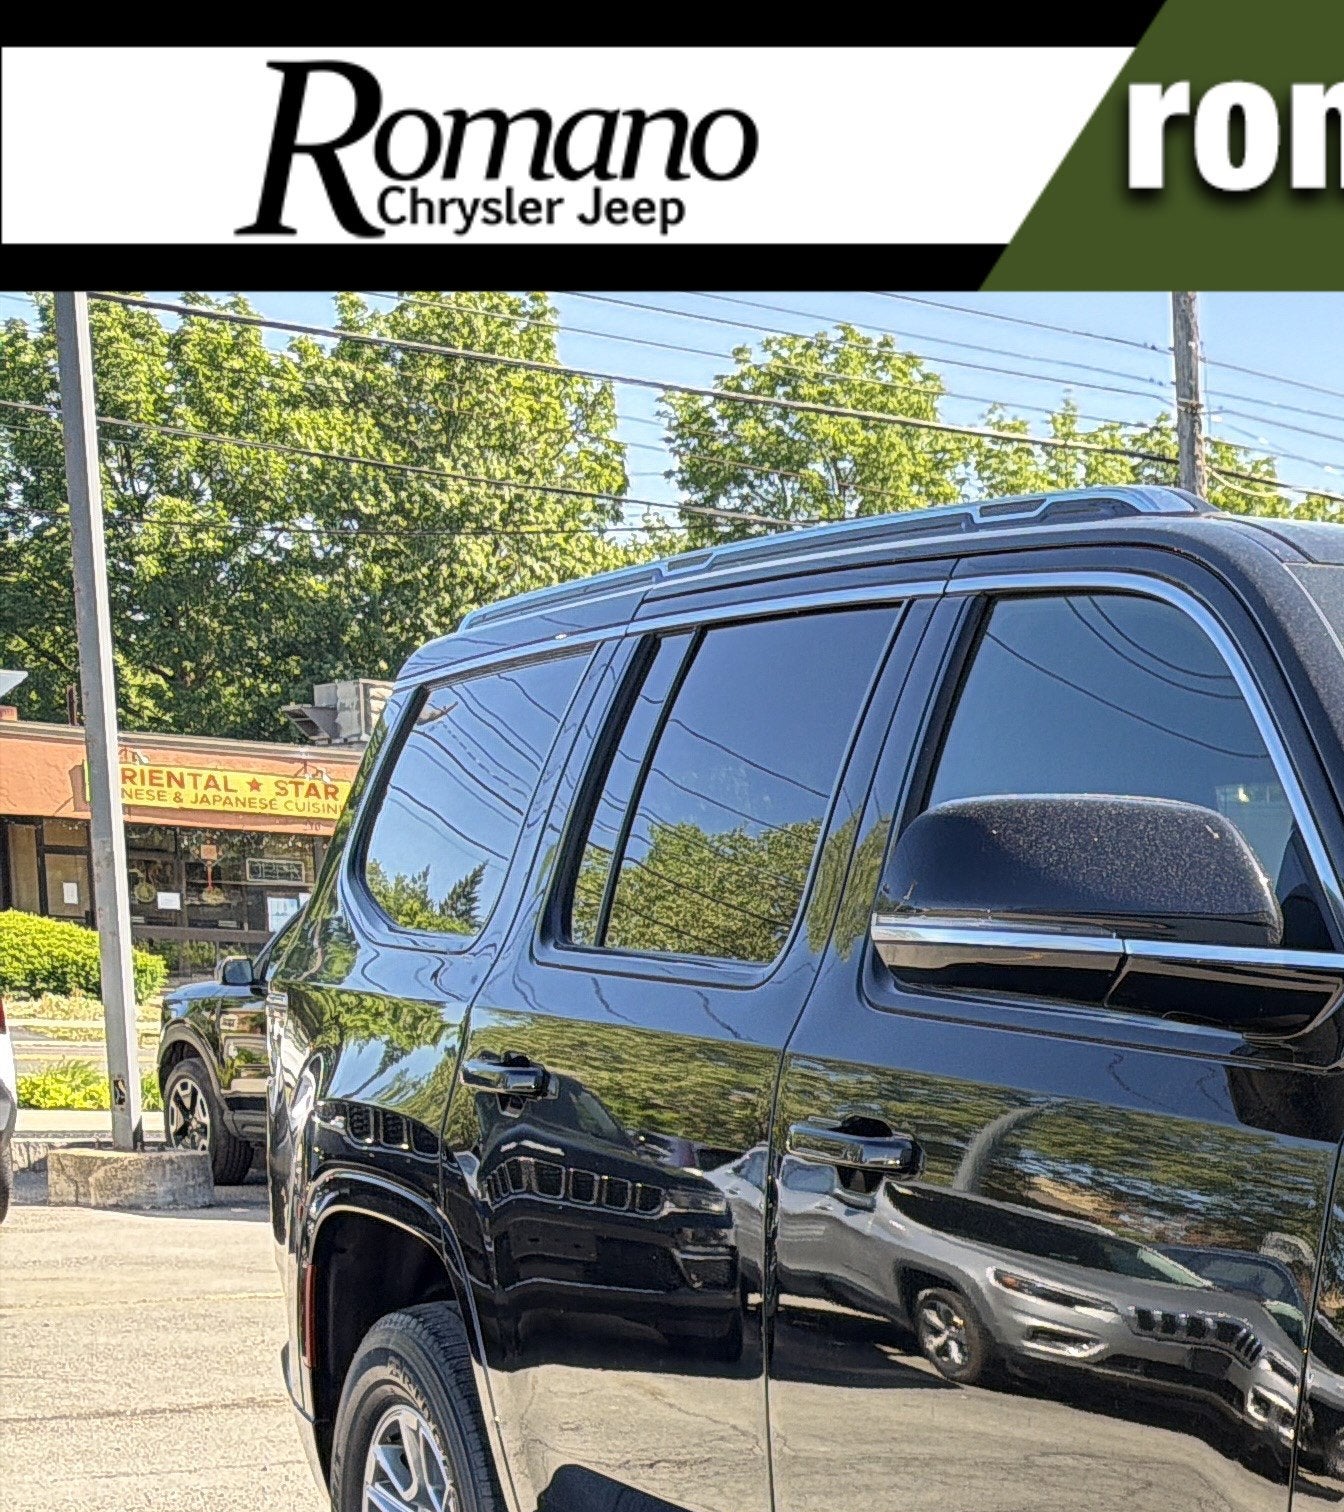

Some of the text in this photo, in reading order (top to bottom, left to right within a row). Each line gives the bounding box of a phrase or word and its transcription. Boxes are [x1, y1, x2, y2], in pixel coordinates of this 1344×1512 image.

[121, 767, 340, 801] RIENTAL STAR
[121, 787, 167, 802] NESE
[173, 791, 184, 803] &
[190, 793, 277, 810] JAPANESE
